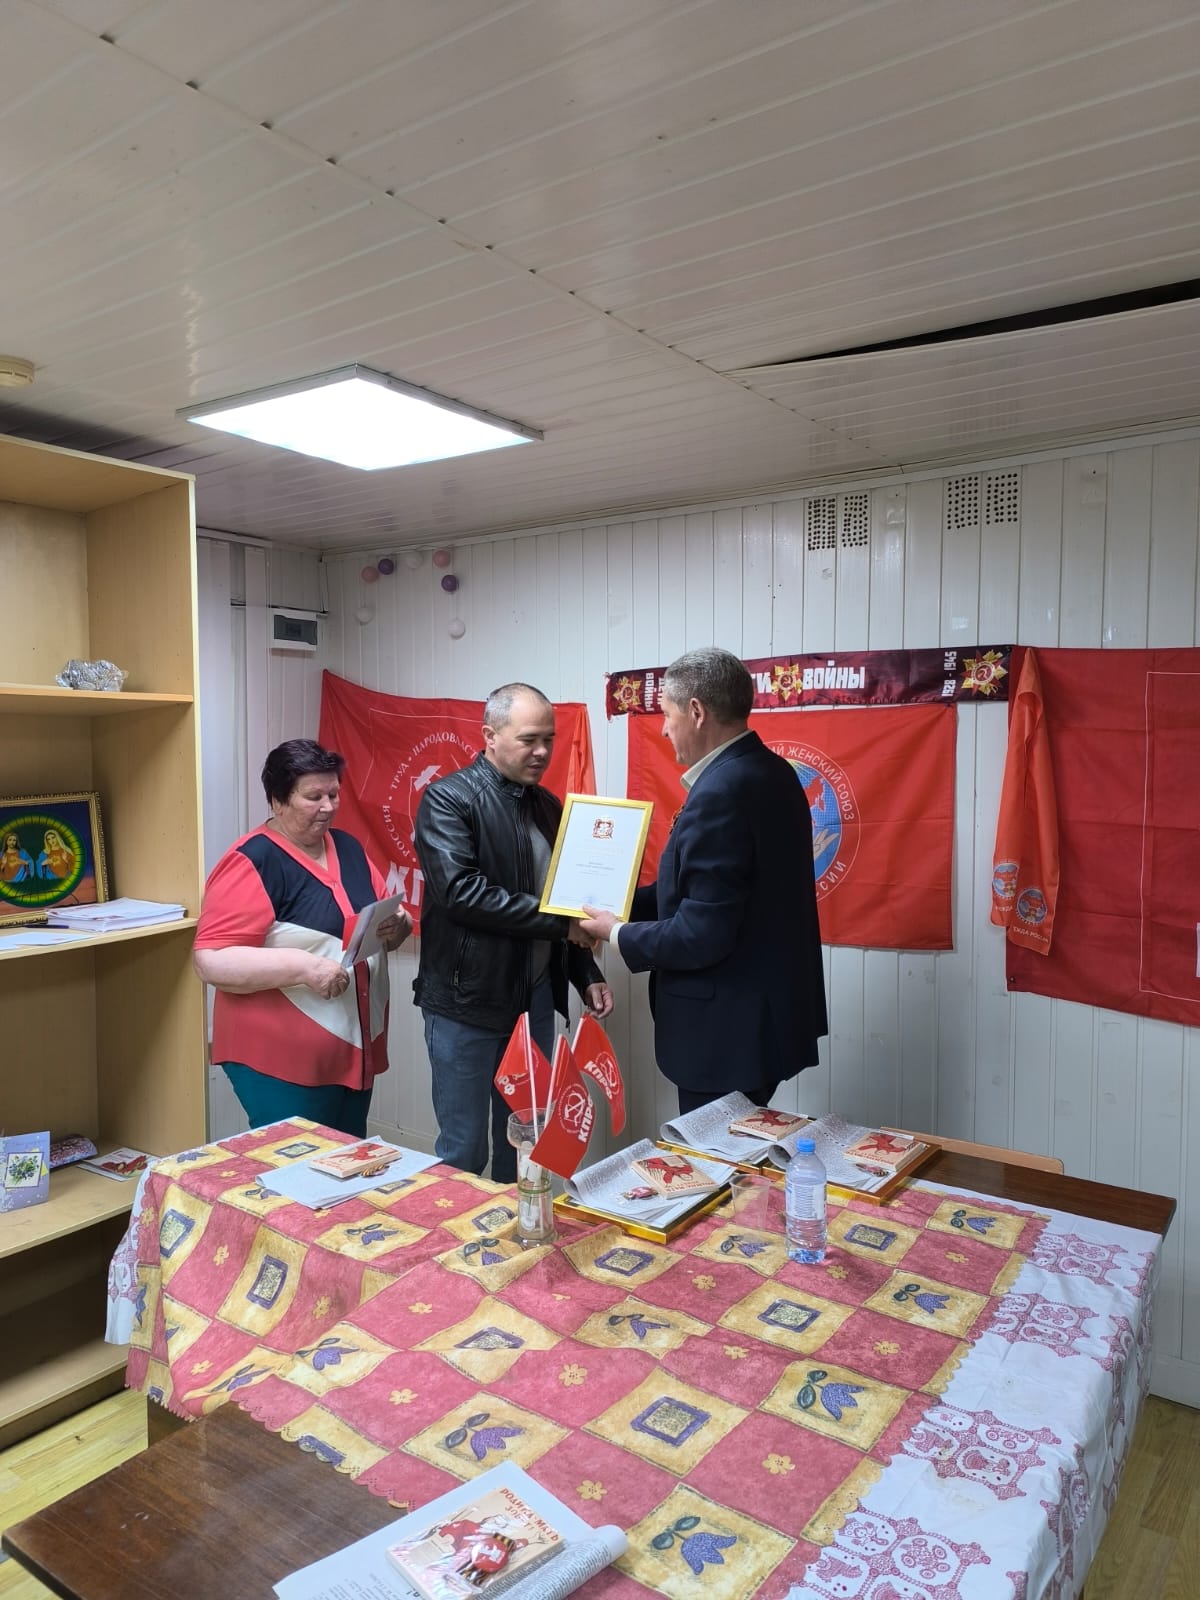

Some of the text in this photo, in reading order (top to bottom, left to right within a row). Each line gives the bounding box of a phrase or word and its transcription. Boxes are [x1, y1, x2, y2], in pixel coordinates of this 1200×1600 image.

[802, 660, 865, 690] ВОЙНЫ
[943, 651, 957, 671] 1945
[645, 672, 657, 712] ВОЙНЫ
[941, 680, 956, 697] 1928
[786, 746, 844, 784] ЖЕНСКИЙ
[836, 783, 855, 821] СОЮЗ
[382, 805, 410, 857] РОССИЯ
